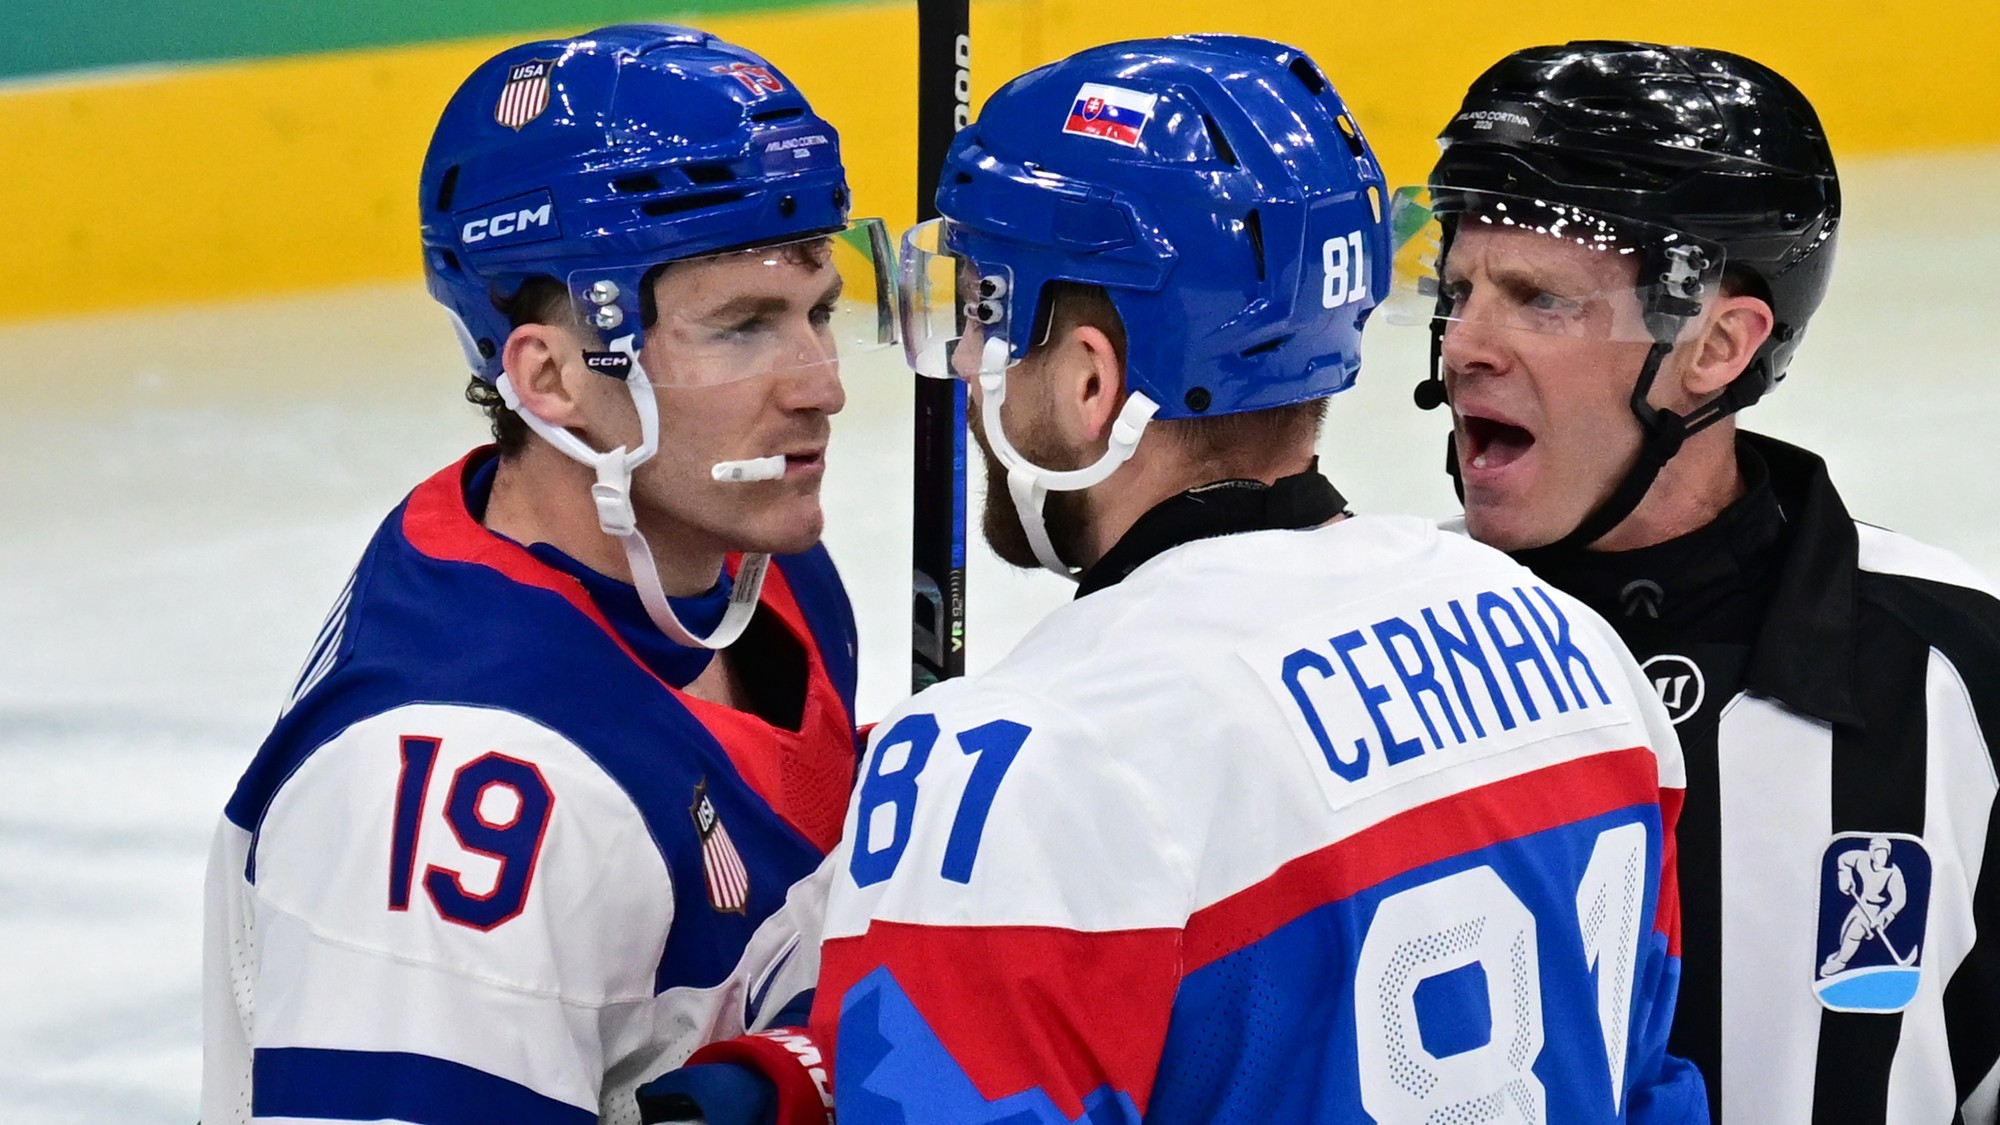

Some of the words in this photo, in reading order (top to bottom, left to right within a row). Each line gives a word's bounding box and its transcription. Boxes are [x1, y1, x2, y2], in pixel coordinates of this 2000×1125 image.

[512, 63, 544, 80] USA
[1472, 120, 1494, 130] 2026
[1487, 111, 1530, 128] CORTINA
[462, 204, 551, 243] CCM
[1322, 229, 1367, 309] 81
[588, 356, 628, 366] CCM
[1282, 586, 1612, 783] CERNAK
[849, 713, 1033, 889] 81
[388, 735, 556, 933] 19
